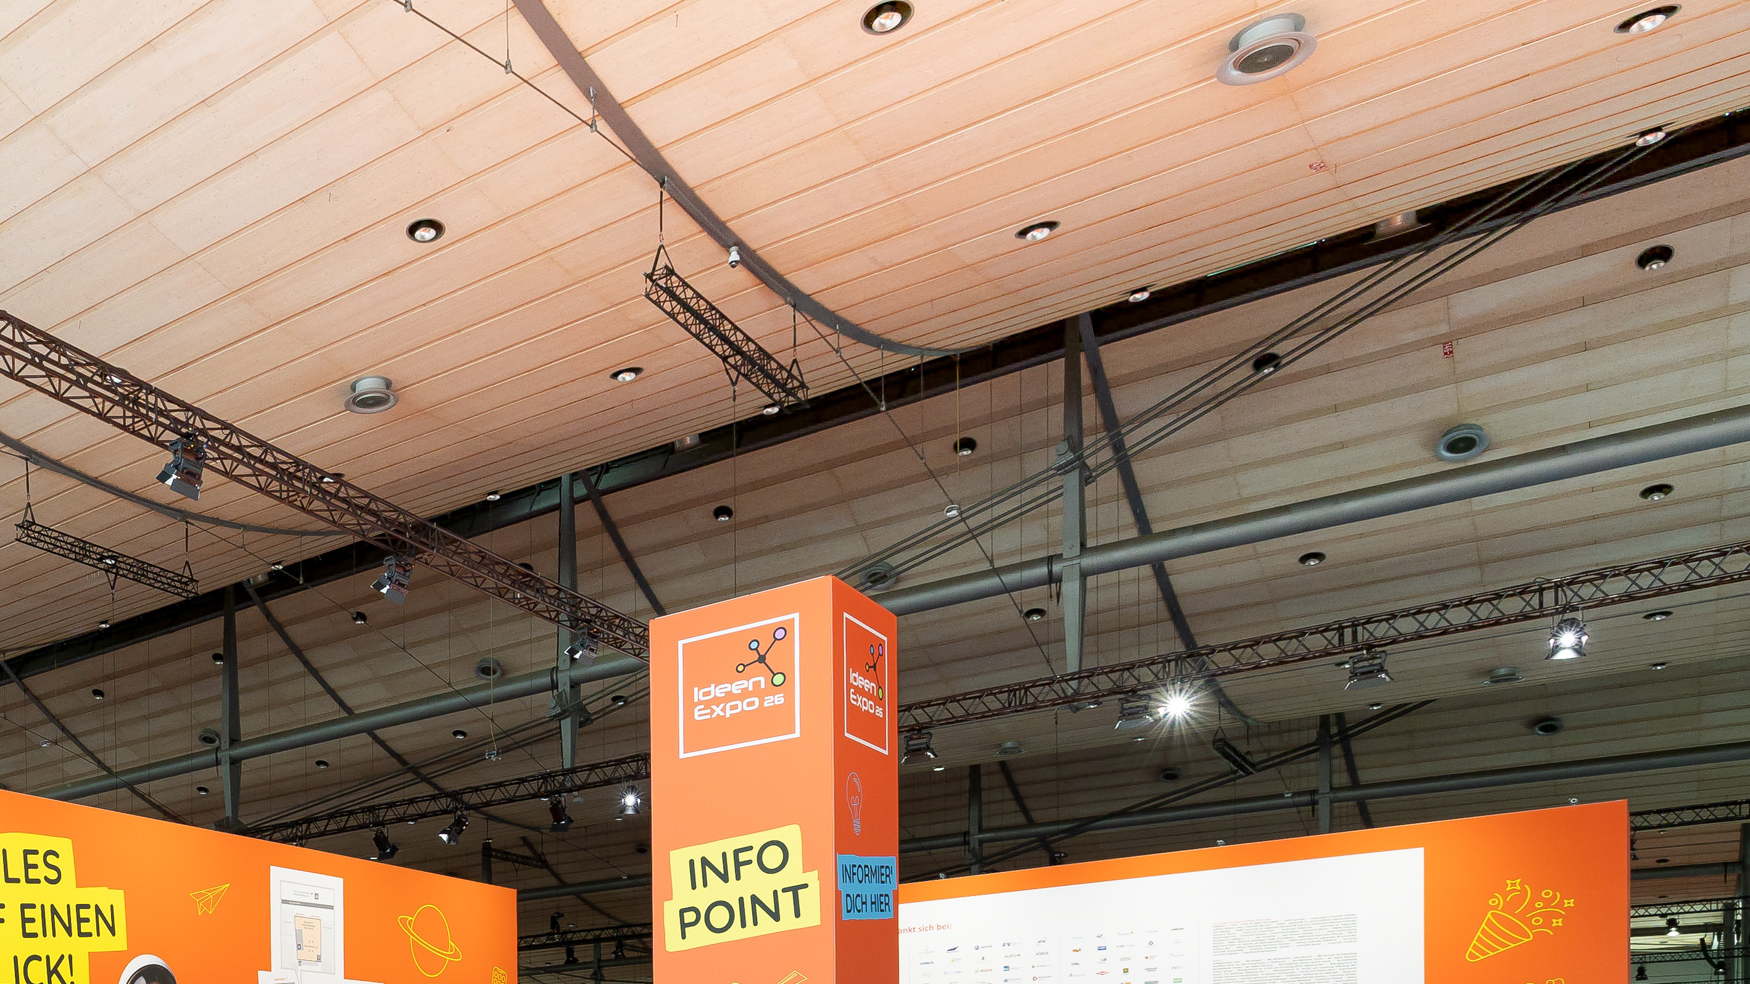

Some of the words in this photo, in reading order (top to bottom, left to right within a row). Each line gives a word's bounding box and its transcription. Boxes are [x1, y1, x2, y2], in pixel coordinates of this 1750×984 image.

[693, 674, 765, 702] Ideen
[849, 668, 877, 697] Ideen
[694, 694, 760, 721] Expo
[763, 693, 785, 707] 26
[849, 693, 875, 714] Expo
[875, 706, 884, 718] 26
[688, 839, 790, 891] INFO
[678, 883, 809, 940] POINT
[845, 891, 868, 914] DICH
[870, 892, 892, 914] HIER
[20, 903, 117, 938] EINEN
[898, 926, 916, 935] ankt
[918, 924, 934, 933] sich
